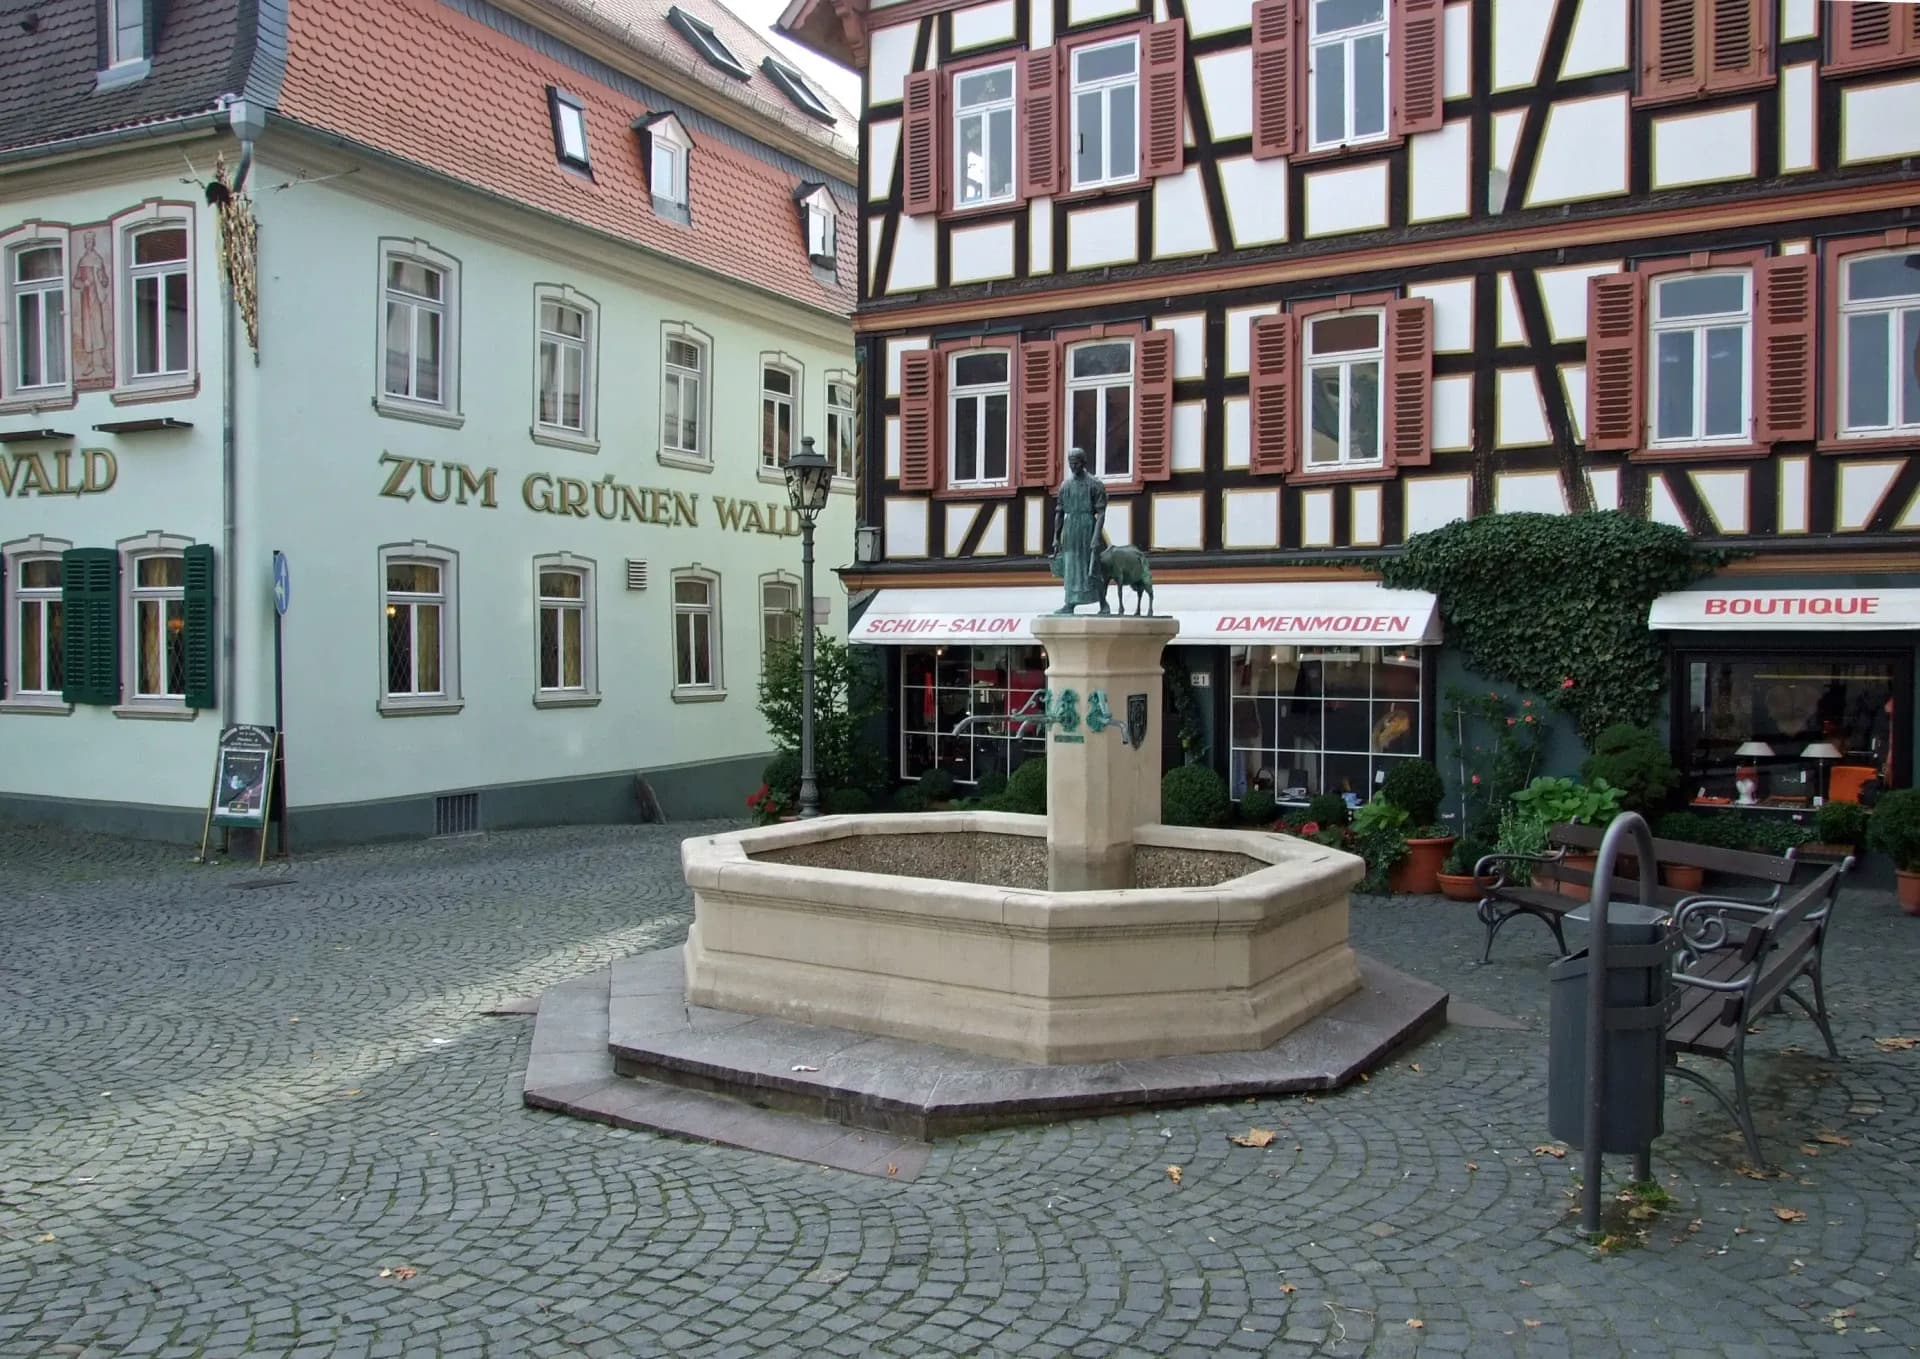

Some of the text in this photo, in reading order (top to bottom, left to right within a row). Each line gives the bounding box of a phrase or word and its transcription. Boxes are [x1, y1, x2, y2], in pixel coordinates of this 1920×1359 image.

[378, 449, 801, 539] ZUM GRÜNEN WALD
[1704, 596, 1880, 616] BOUTIQUE
[866, 617, 1021, 634] SCHUH-SALON
[1215, 615, 1410, 633] DAMENMODEN
